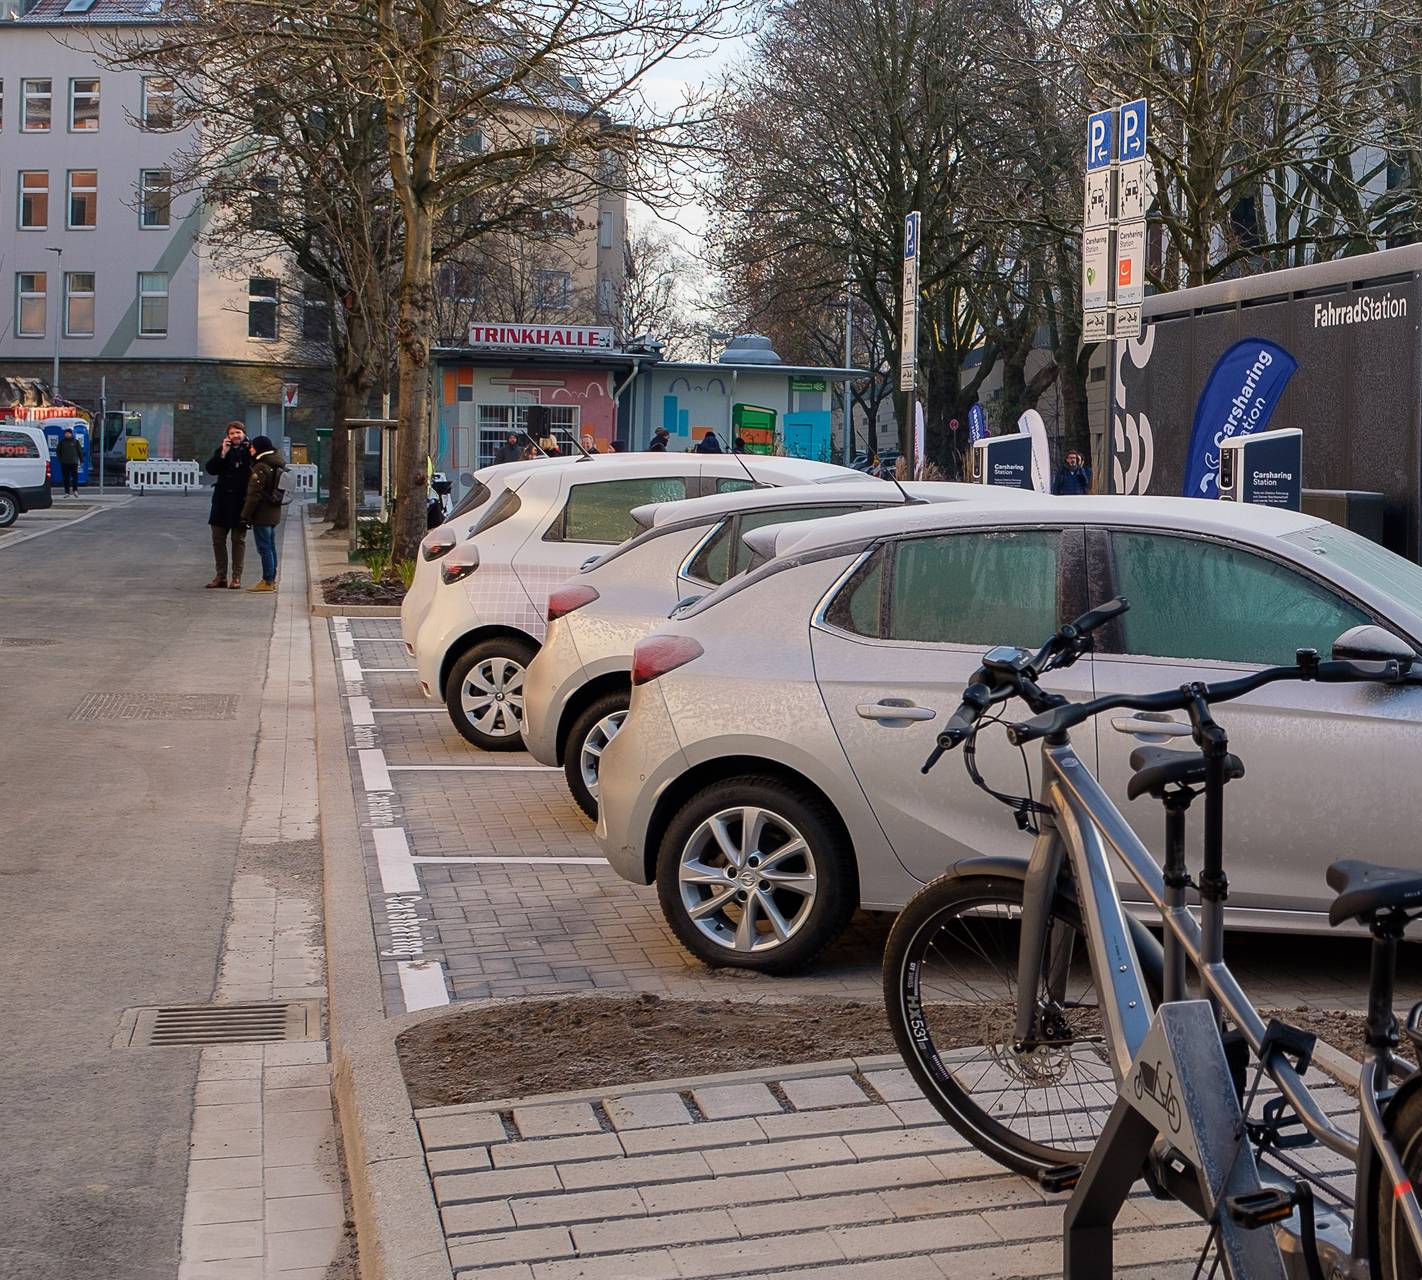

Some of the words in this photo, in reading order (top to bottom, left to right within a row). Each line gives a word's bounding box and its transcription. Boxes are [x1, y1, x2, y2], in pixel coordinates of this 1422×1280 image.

[1086, 237, 1107, 246] Carsharing
[1120, 230, 1143, 240] Carsharing
[1314, 292, 1407, 328] FahrradStation
[472, 327, 600, 346] TRINKHALLE
[1214, 350, 1273, 448] Carsharing
[1240, 397, 1267, 437] ation
[994, 463, 1024, 471] Carsharing
[1253, 471, 1292, 480] Carsharing
